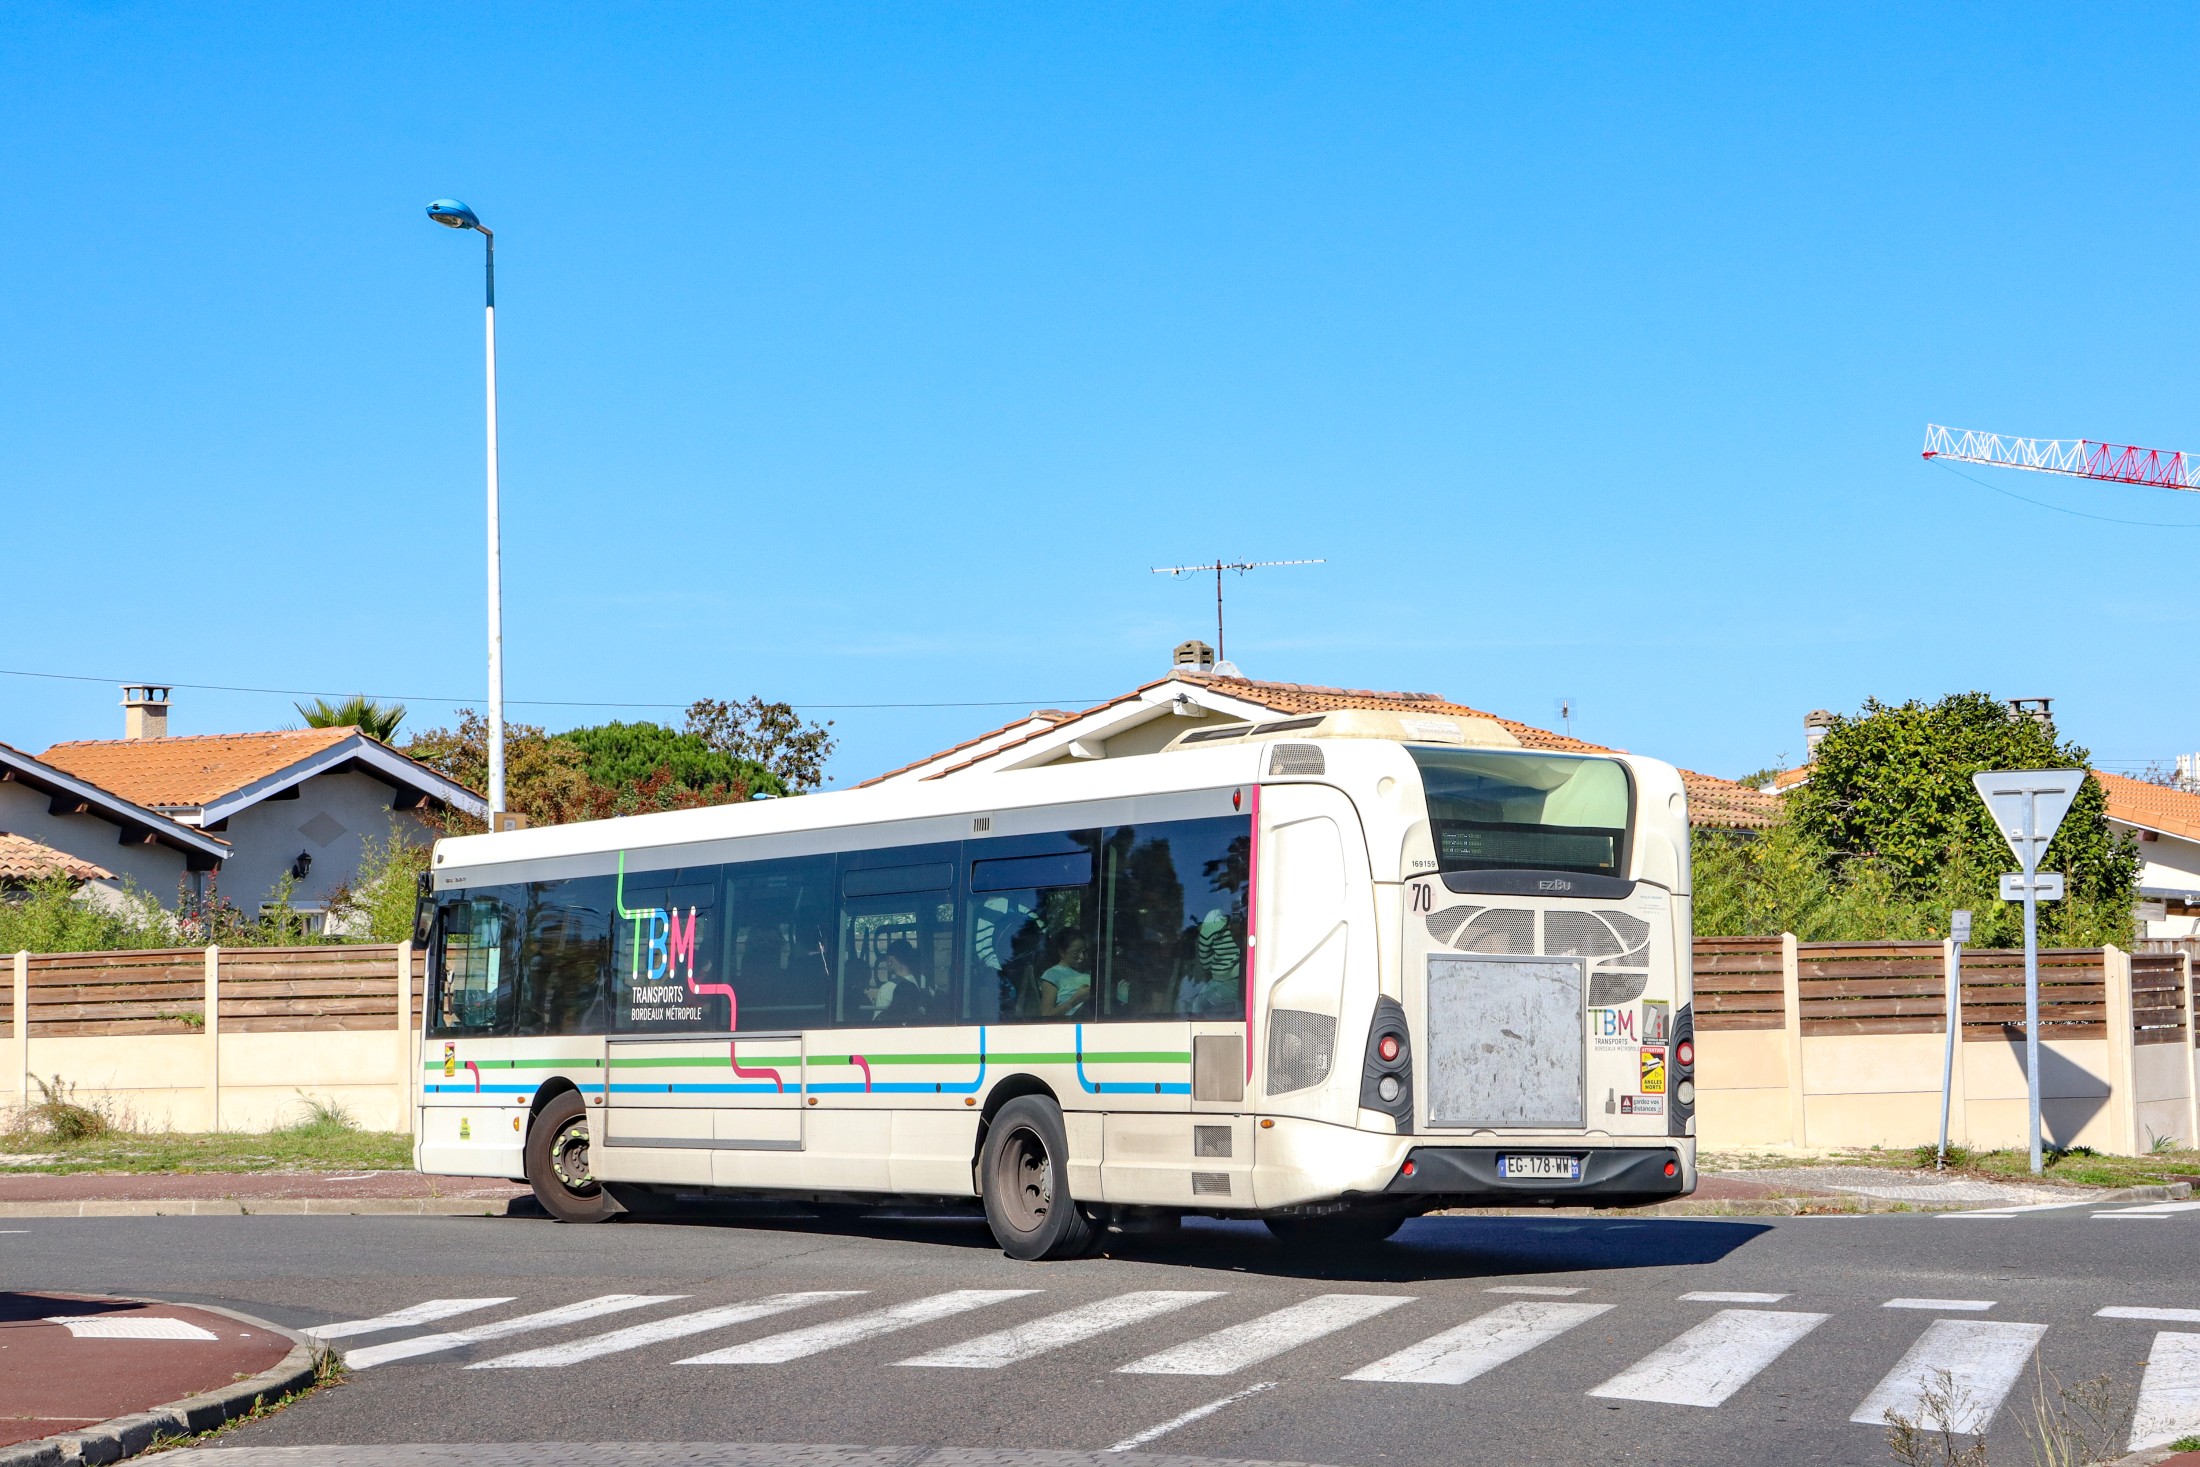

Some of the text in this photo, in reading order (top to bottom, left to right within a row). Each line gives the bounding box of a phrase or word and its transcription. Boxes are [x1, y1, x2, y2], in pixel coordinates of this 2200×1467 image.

[1412, 883, 1431, 912] 70
[625, 906, 698, 980] TBM
[632, 985, 684, 1004] TRANSPORTS
[631, 1004, 702, 1021] BORDEAUX MÉTROPOLE
[1588, 1008, 1637, 1041] TBM
[1594, 1037, 1628, 1045] TRANSPORTS
[1508, 1157, 1569, 1174] EG-178-WW
[1572, 1166, 1579, 1175] 33
